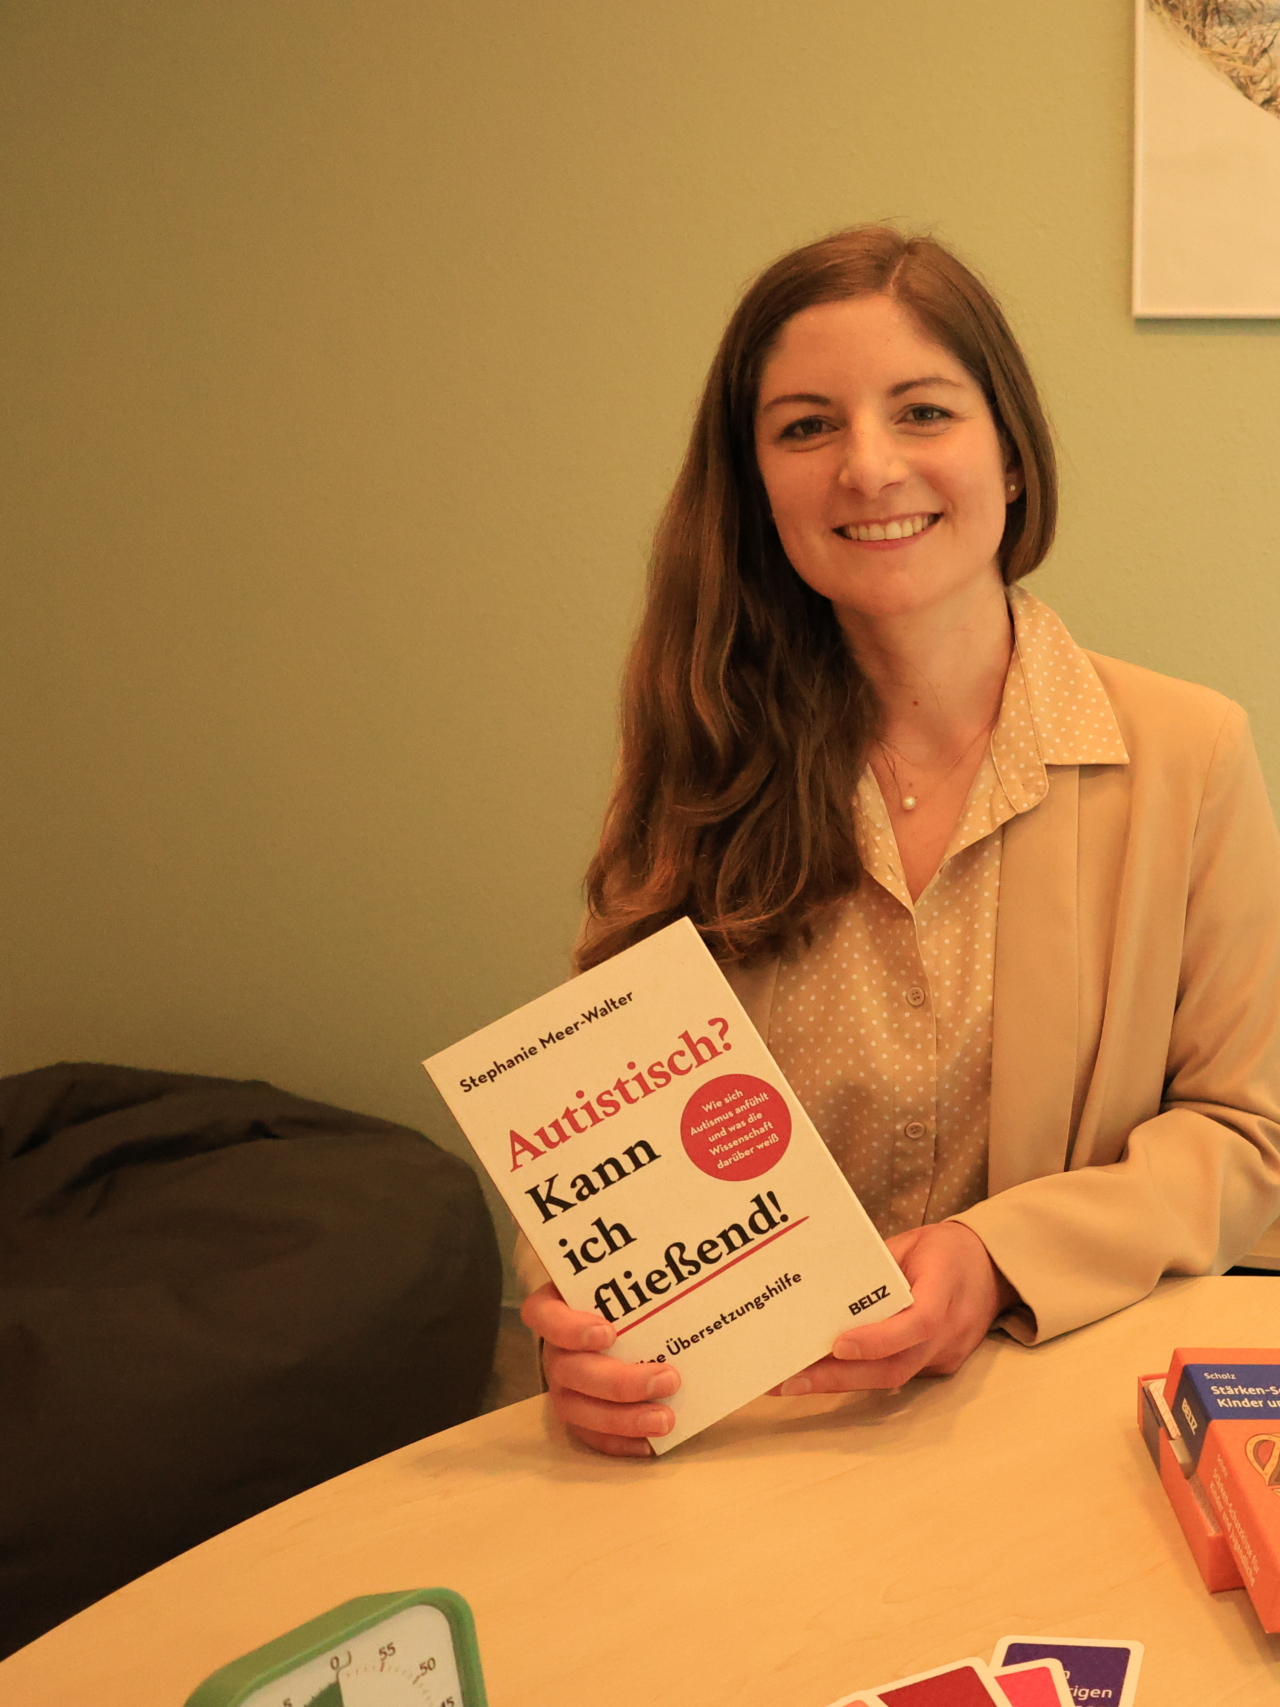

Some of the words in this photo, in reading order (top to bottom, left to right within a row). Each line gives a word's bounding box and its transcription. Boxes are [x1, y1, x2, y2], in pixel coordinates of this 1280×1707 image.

[459, 1047, 538, 1093] Stephanie
[538, 991, 634, 1049] Meer-Walter
[509, 1017, 732, 1173] Autistisch?
[701, 1100, 723, 1113] Wie
[723, 1089, 744, 1104] sich
[690, 1110, 734, 1136] Autismus
[735, 1092, 769, 1114] anfühlt
[708, 1127, 727, 1142] und
[728, 1120, 746, 1133] was
[747, 1112, 763, 1124] die
[708, 1121, 774, 1156] Wissenschaft
[717, 1147, 755, 1169] darüber
[756, 1133, 780, 1150] weiß
[524, 1139, 662, 1224] Kann
[558, 1216, 638, 1276] ich
[593, 1190, 789, 1324] fließend!
[665, 1272, 802, 1356] Übersetzungshilfe
[848, 1285, 891, 1316] BELTZ
[1203, 1372, 1237, 1380] Scholz
[1181, 1397, 1198, 1435] BELTZ
[1217, 1398, 1265, 1408] Kinder
[330, 1656, 340, 1670] 0
[378, 1642, 397, 1661] 55
[419, 1657, 436, 1676] 50
